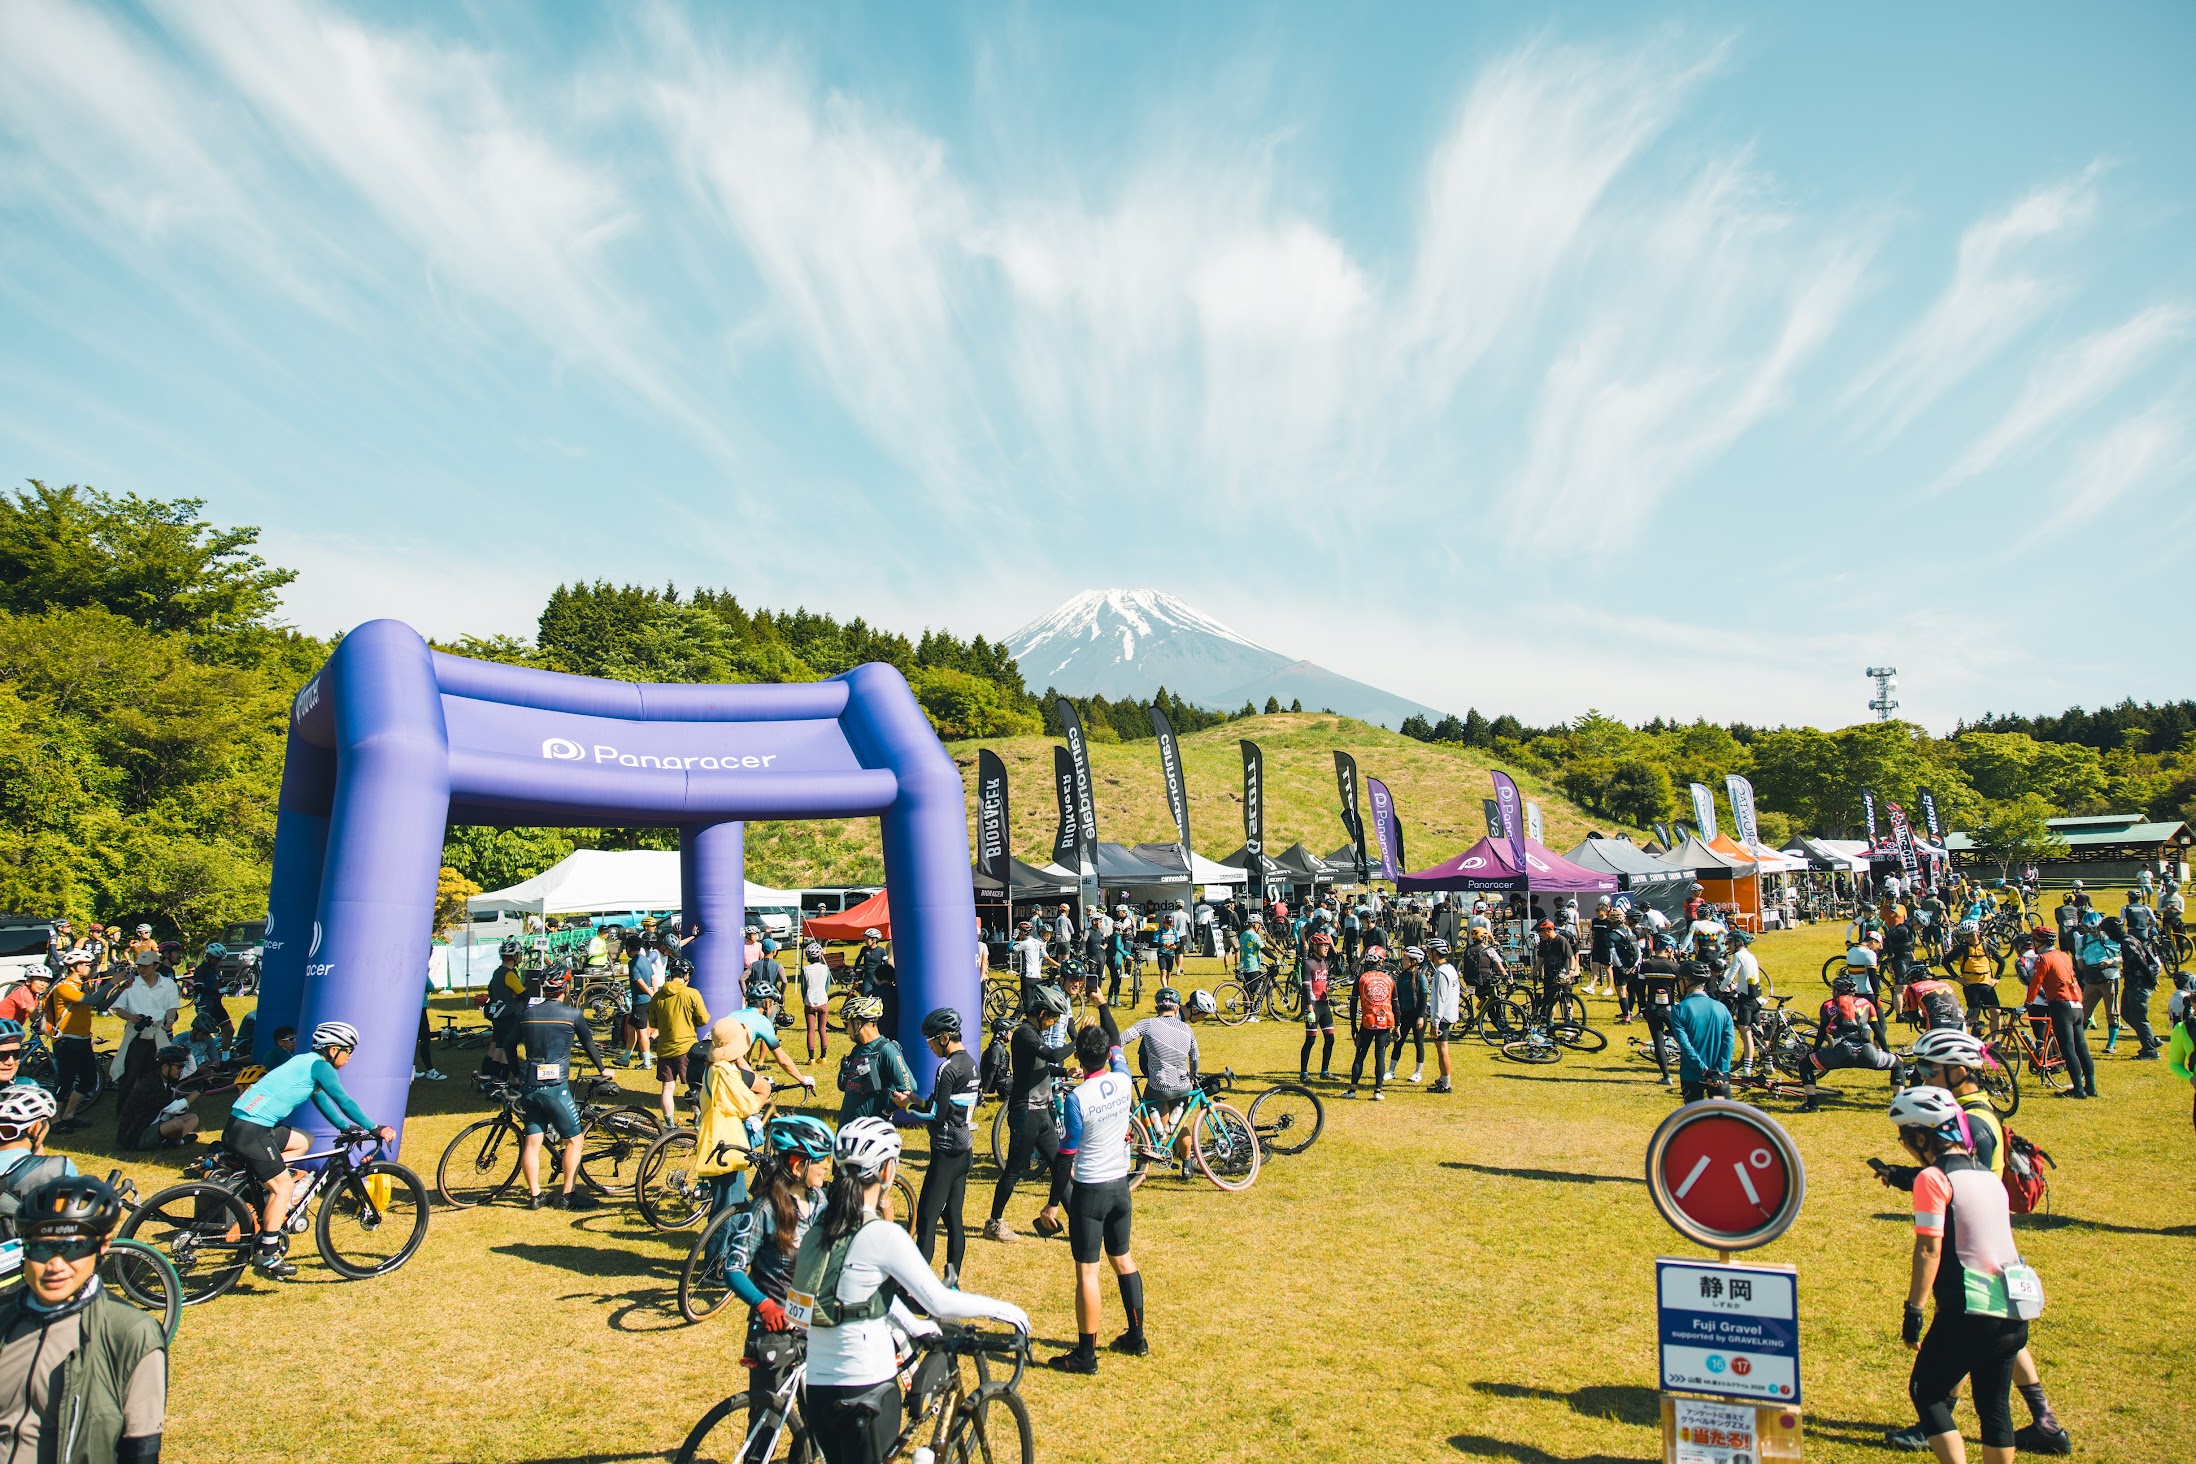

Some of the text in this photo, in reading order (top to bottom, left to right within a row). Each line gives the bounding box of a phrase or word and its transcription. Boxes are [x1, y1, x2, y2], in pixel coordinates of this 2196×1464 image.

[593, 744, 777, 770] Panaracer
[1864, 795, 1876, 834] vittoria
[1923, 794, 1939, 834] vittoria
[1376, 810, 1392, 875] Panaracer
[1161, 874, 1189, 882] cannondale
[1219, 872, 1244, 880] cannondale
[1468, 880, 1515, 889] Panaracer
[980, 890, 1004, 898] BIORACER
[1088, 1094, 1131, 1117] Panarace
[1098, 1112, 1118, 1122] Cycling
[286, 1170, 330, 1228] GIANT
[1700, 1276, 1752, 1302] 静岡
[2020, 1282, 2032, 1293] 58
[788, 1302, 805, 1320] 207
[1712, 1300, 1741, 1310] しずおか
[1692, 1318, 1762, 1336] Fuji Gravel
[1671, 1331, 1785, 1348] supported by GRAVELKING
[1712, 1358, 1749, 1372] 16 17
